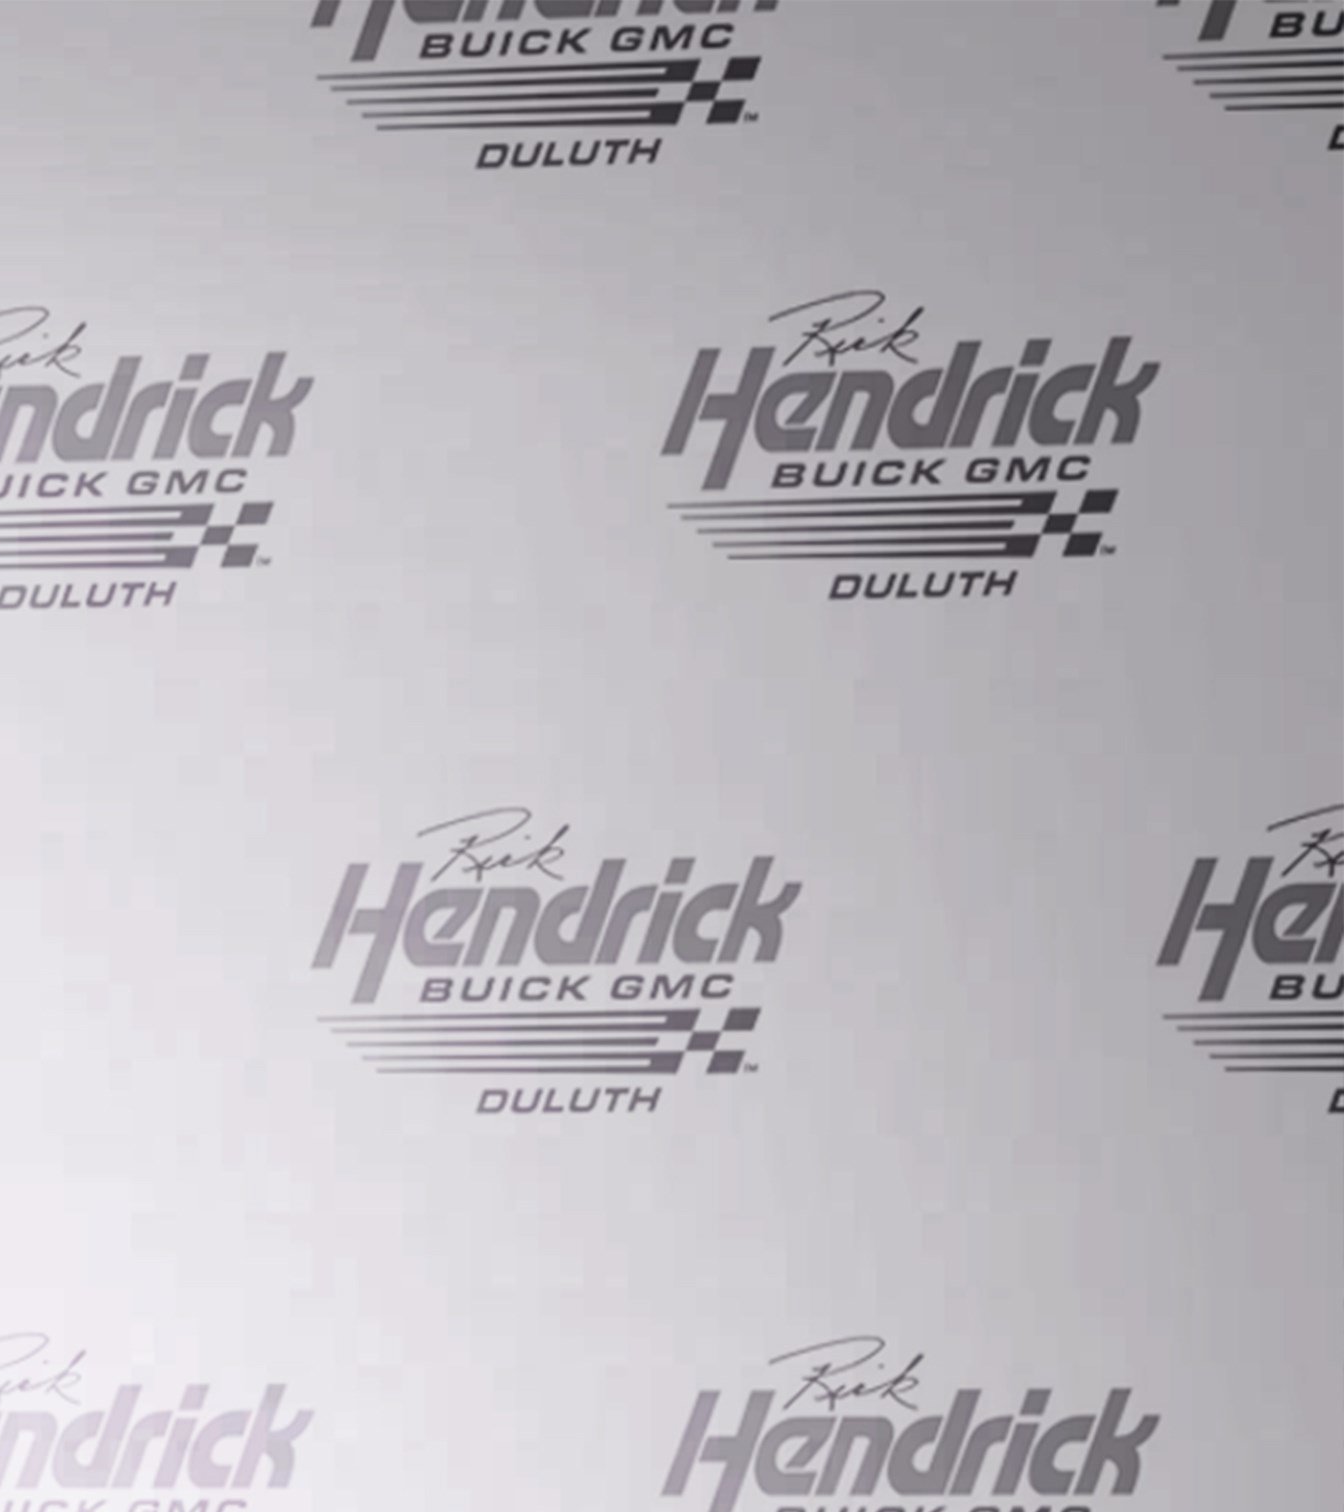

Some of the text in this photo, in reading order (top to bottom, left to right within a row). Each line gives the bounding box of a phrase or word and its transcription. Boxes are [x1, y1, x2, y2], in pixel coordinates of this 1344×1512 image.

[418, 23, 734, 60] BUICK GMC
[475, 137, 662, 170] DULUTH
[660, 335, 1161, 490] Hendrick
[126, 468, 248, 497] GMC
[770, 455, 1093, 488] BUICK GMC
[828, 570, 1018, 600] DULUTH
[311, 856, 802, 1004] Hendrick
[418, 972, 734, 1004] BUICK GMC
[475, 1086, 662, 1114] DULUTH
